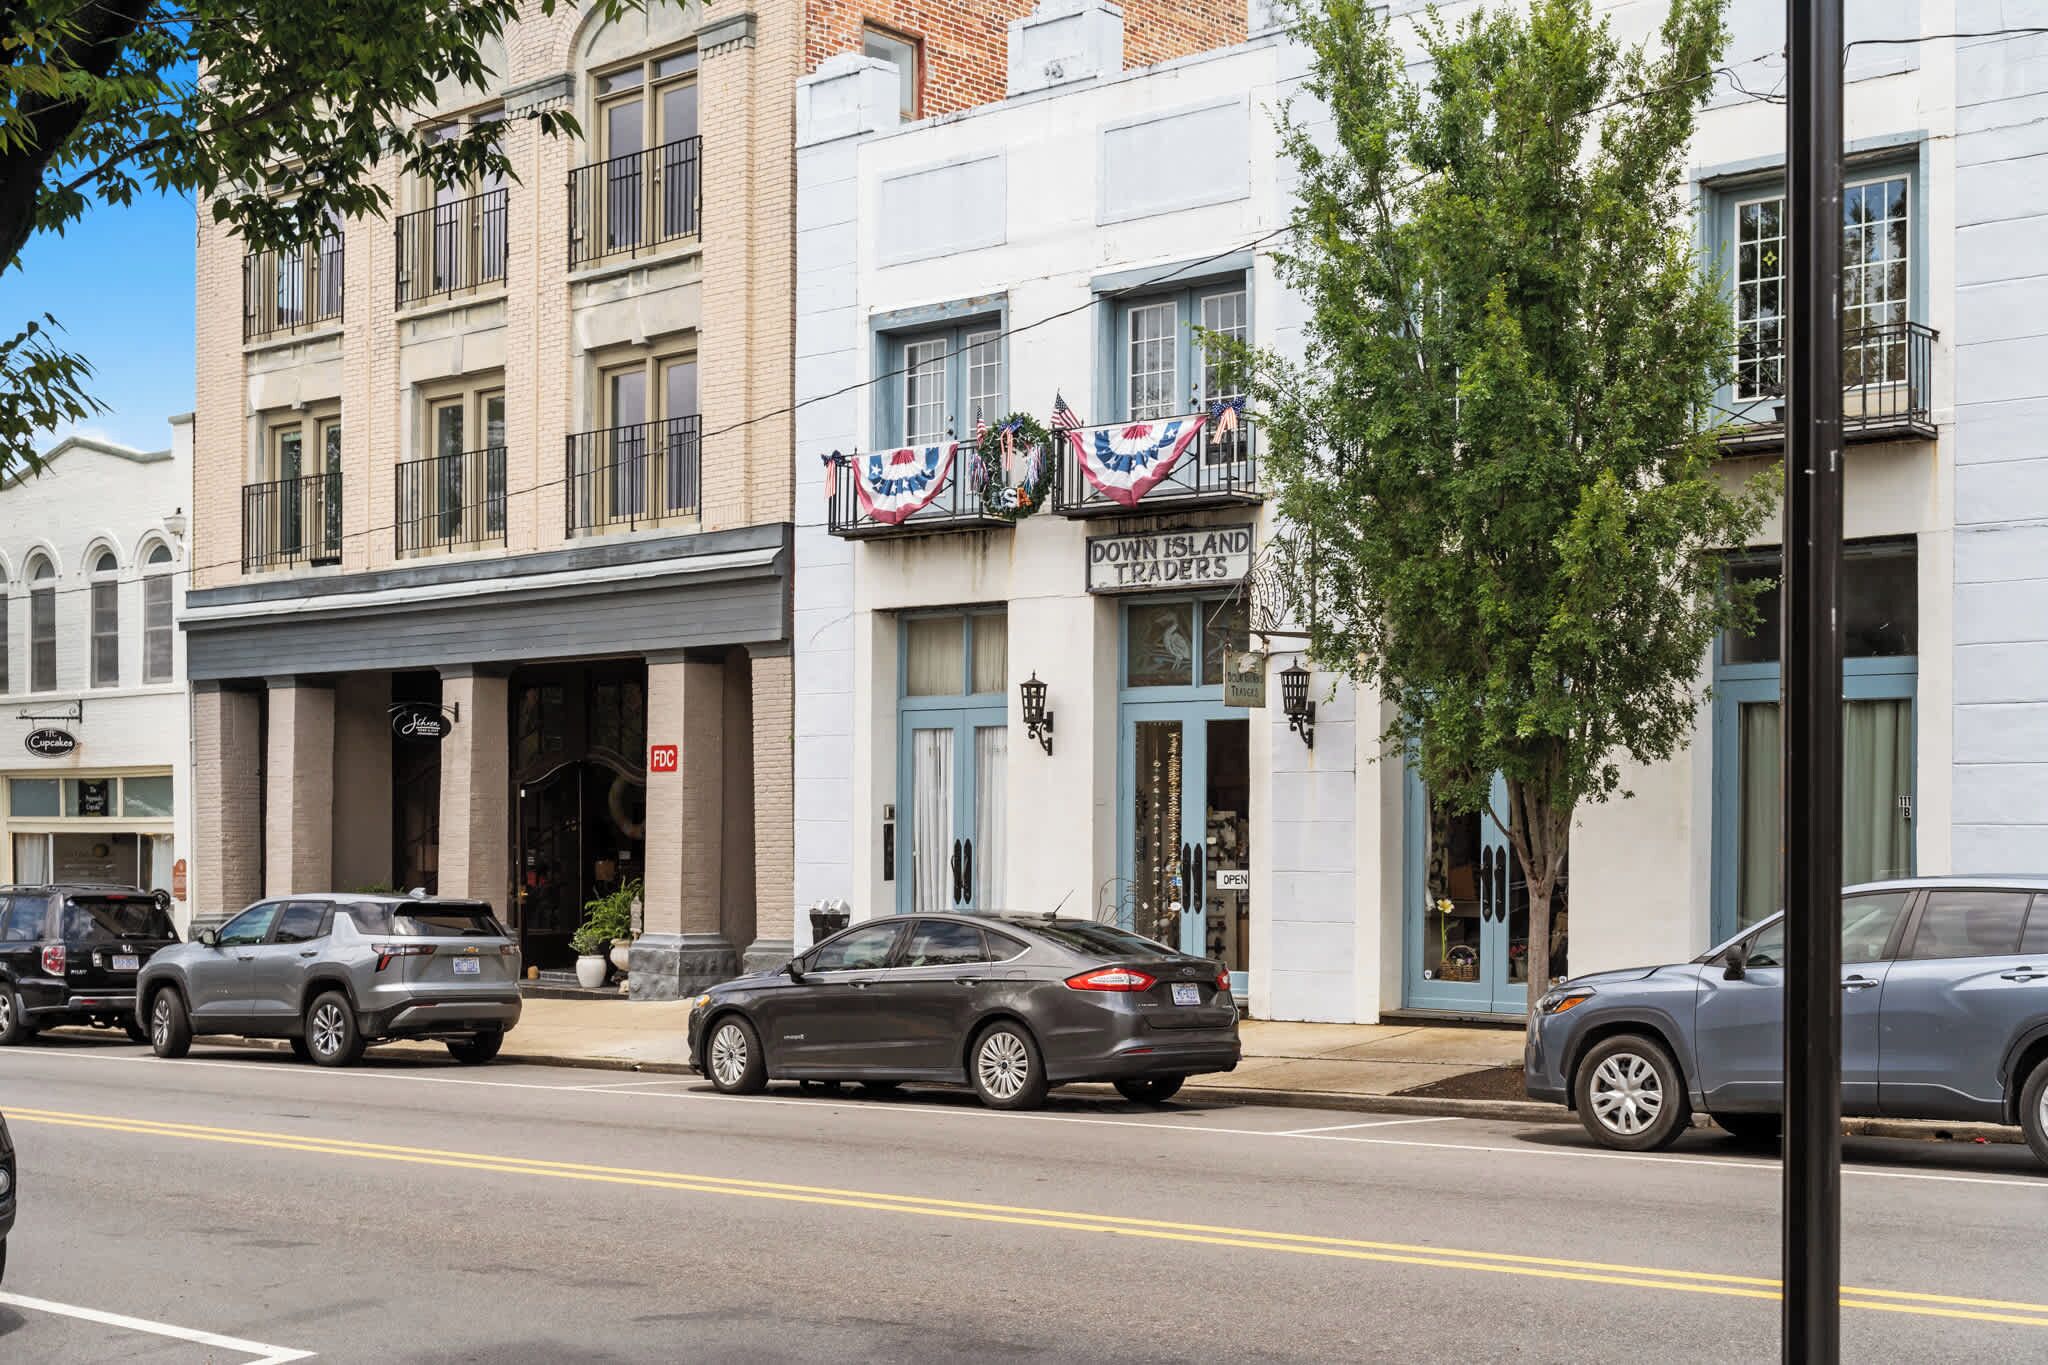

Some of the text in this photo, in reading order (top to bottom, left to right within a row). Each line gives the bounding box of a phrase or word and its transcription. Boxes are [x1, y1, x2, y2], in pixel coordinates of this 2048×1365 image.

[991, 487, 1032, 509] USA
[1092, 531, 1249, 563] DOWN ISLAND
[1114, 556, 1228, 584] TRADERS
[30, 735, 73, 751] Cupcakes
[653, 749, 675, 768] FDC
[1899, 796, 1911, 806] 111
[1904, 806, 1911, 816] B
[1223, 874, 1248, 885] OPEN
